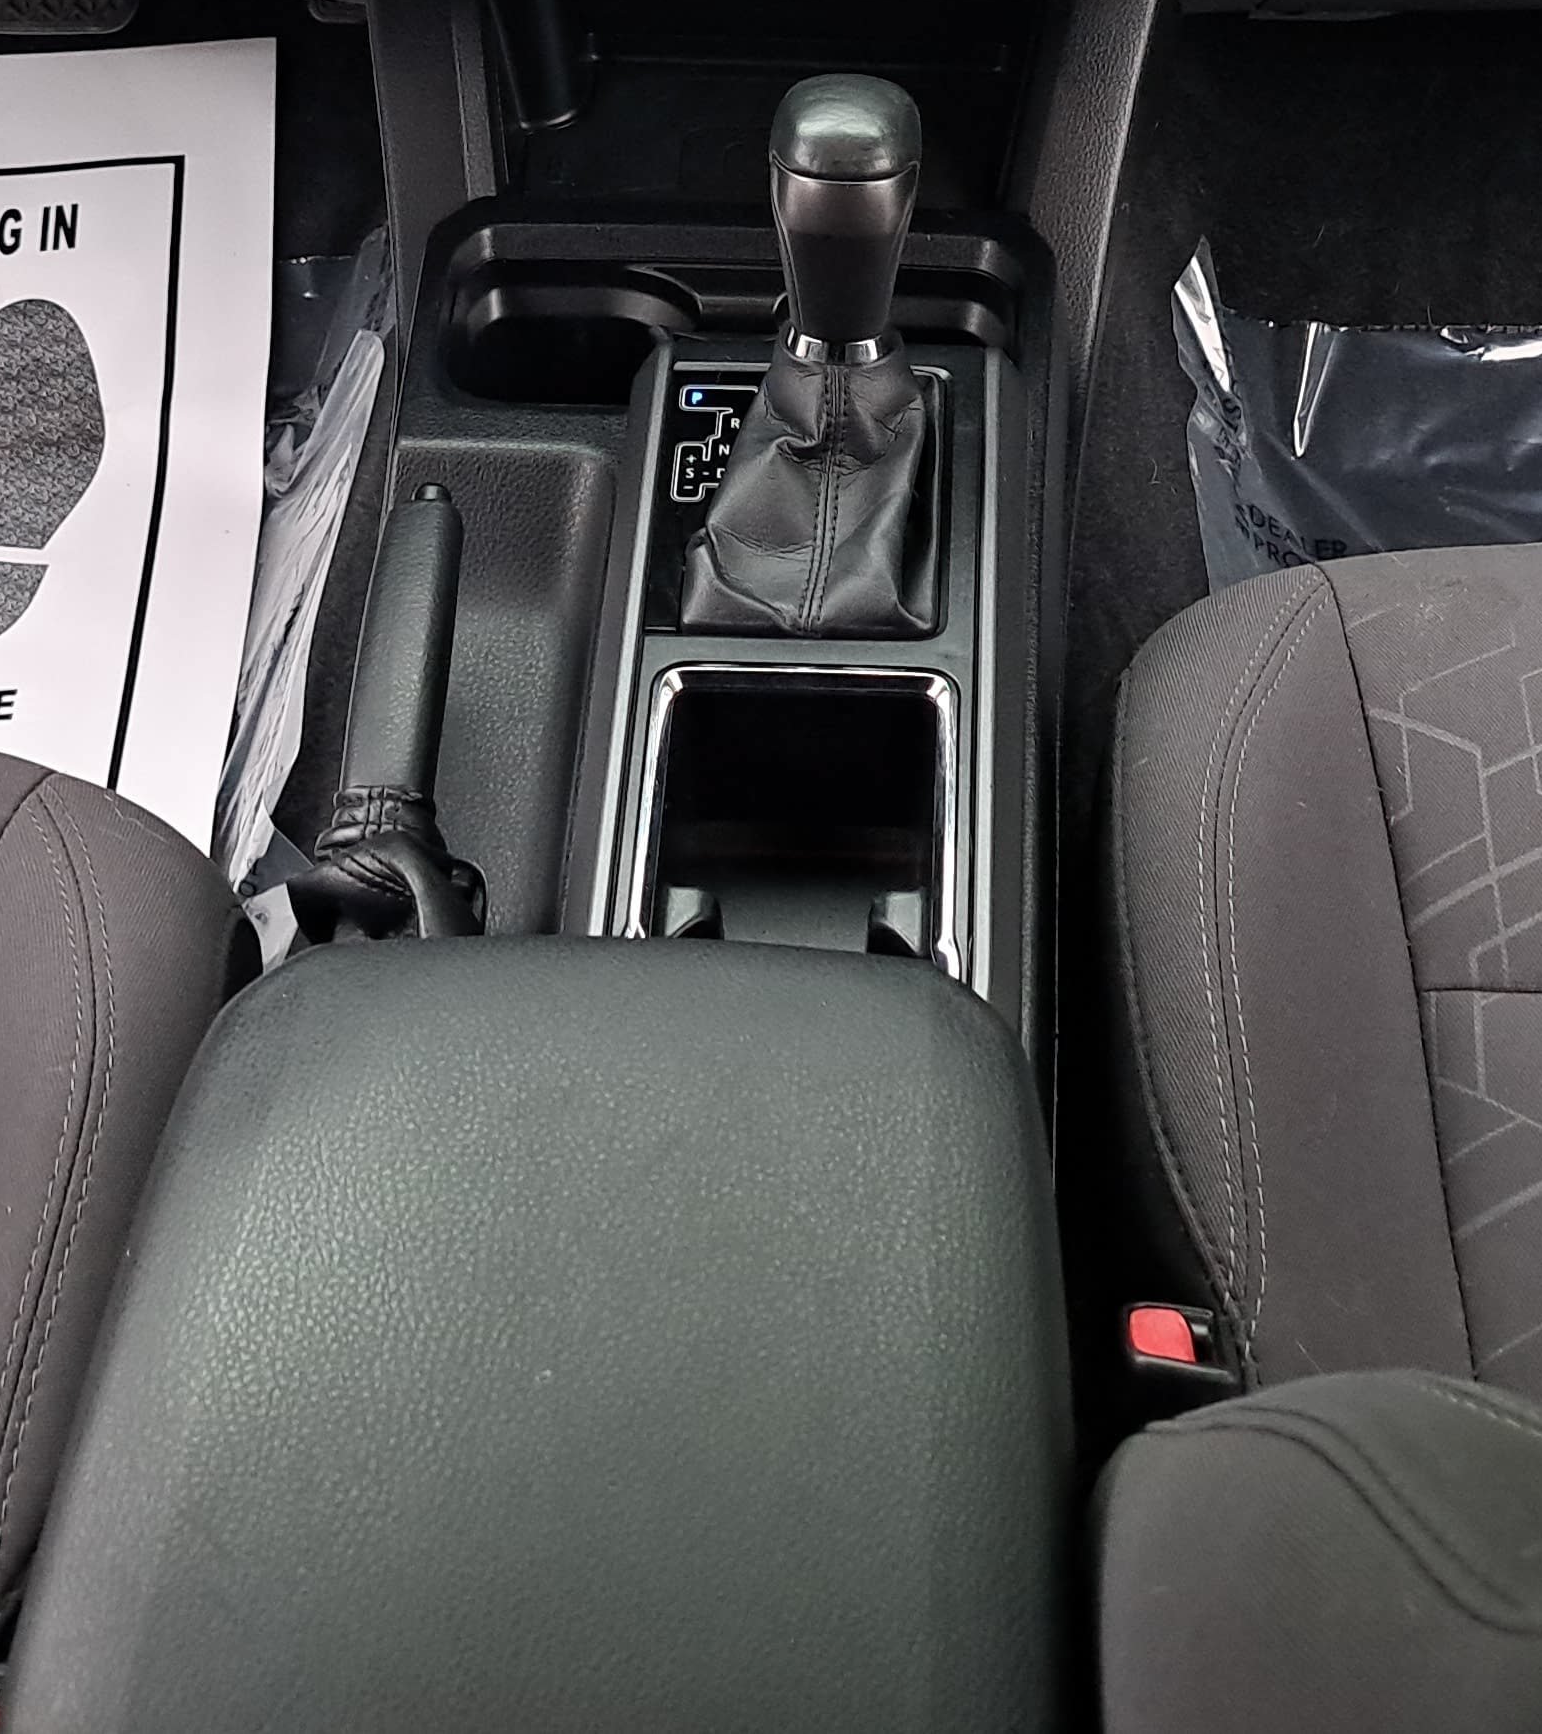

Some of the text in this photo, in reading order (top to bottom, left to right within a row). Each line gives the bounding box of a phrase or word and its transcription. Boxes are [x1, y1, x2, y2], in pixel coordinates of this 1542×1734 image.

[39, 203, 80, 252] IN
[691, 391, 703, 405] P
[731, 418, 740, 429] R
[719, 445, 730, 456] N
[685, 468, 694, 479] S
